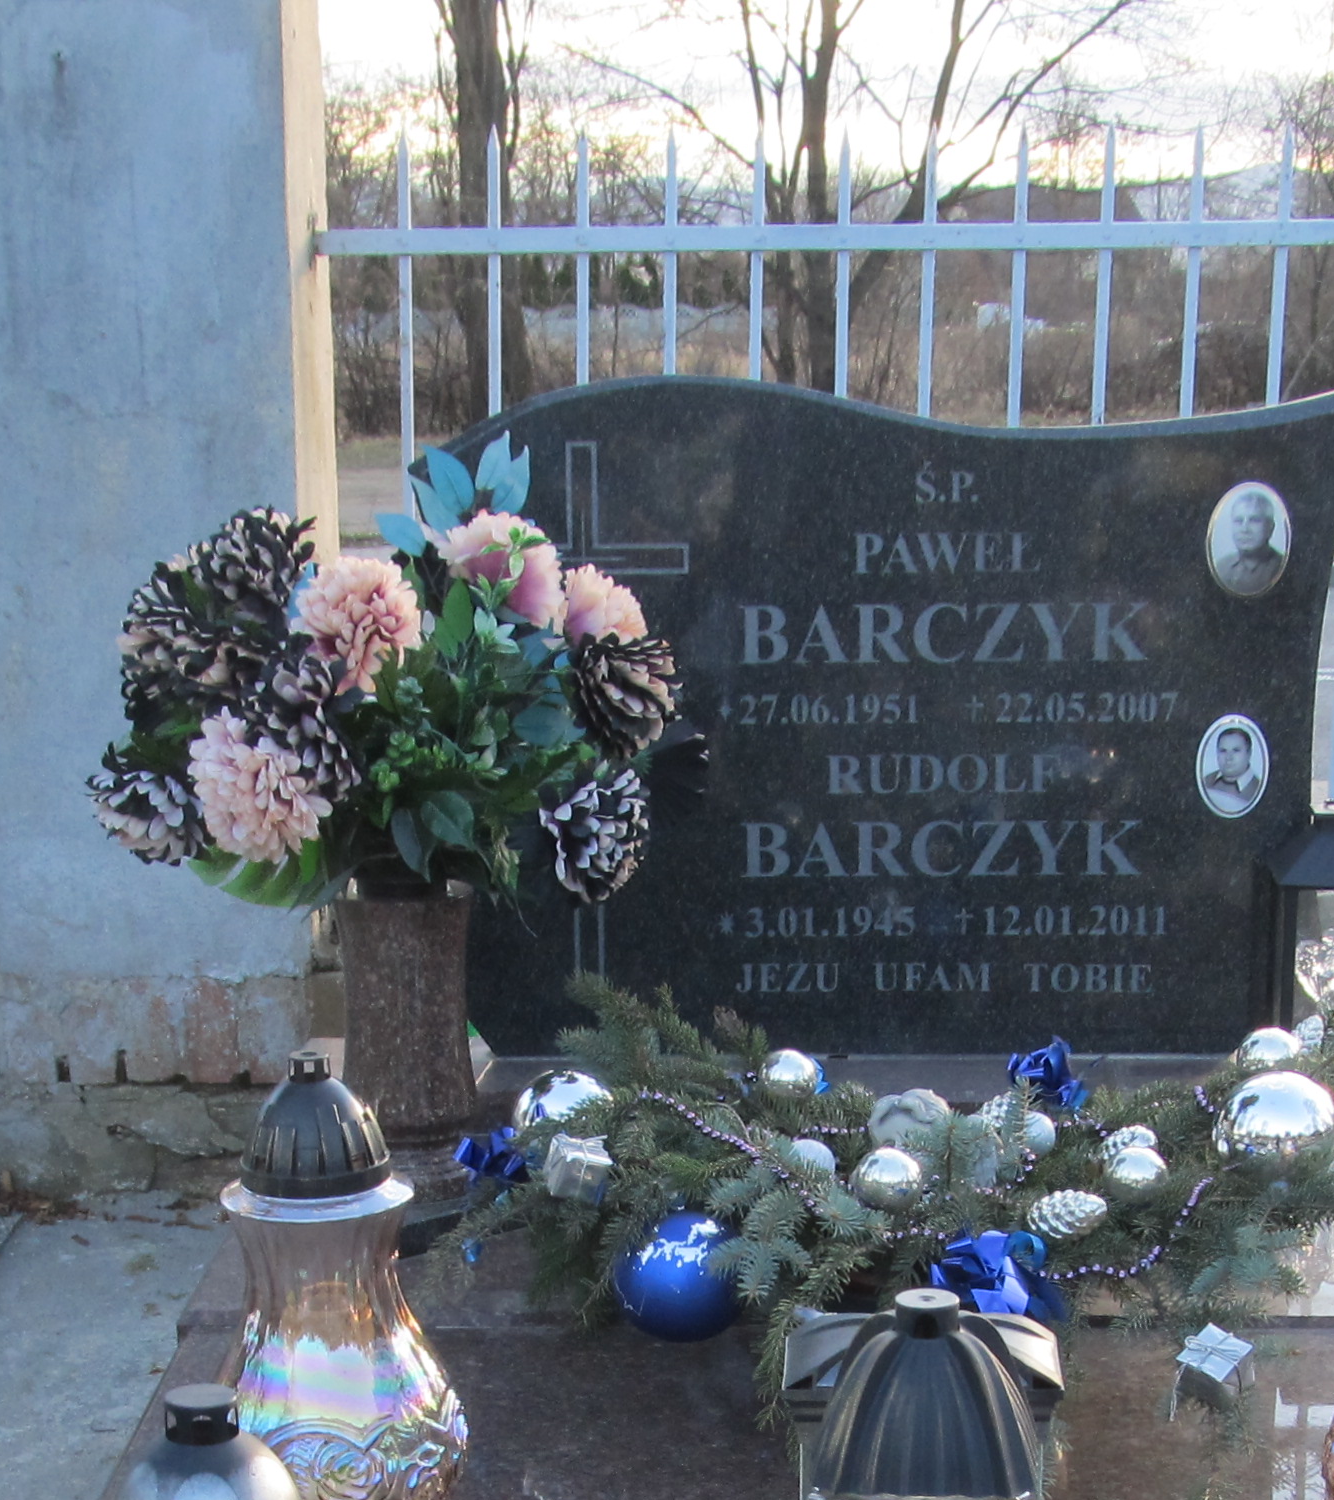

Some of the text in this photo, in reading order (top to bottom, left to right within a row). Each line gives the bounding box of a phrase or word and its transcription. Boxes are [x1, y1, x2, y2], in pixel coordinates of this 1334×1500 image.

[854, 532, 1042, 575] PAWEŁ
[740, 603, 1150, 664] BARCZYK
[739, 691, 1178, 725] 27.06.1951 22.05.2007
[827, 754, 1060, 795] RUDOLF
[741, 819, 1142, 878] BARCZYK
[745, 904, 1167, 939] 3.01.1945 12.01.2011
[735, 961, 1153, 994] JEZU UFAM TOBIE
